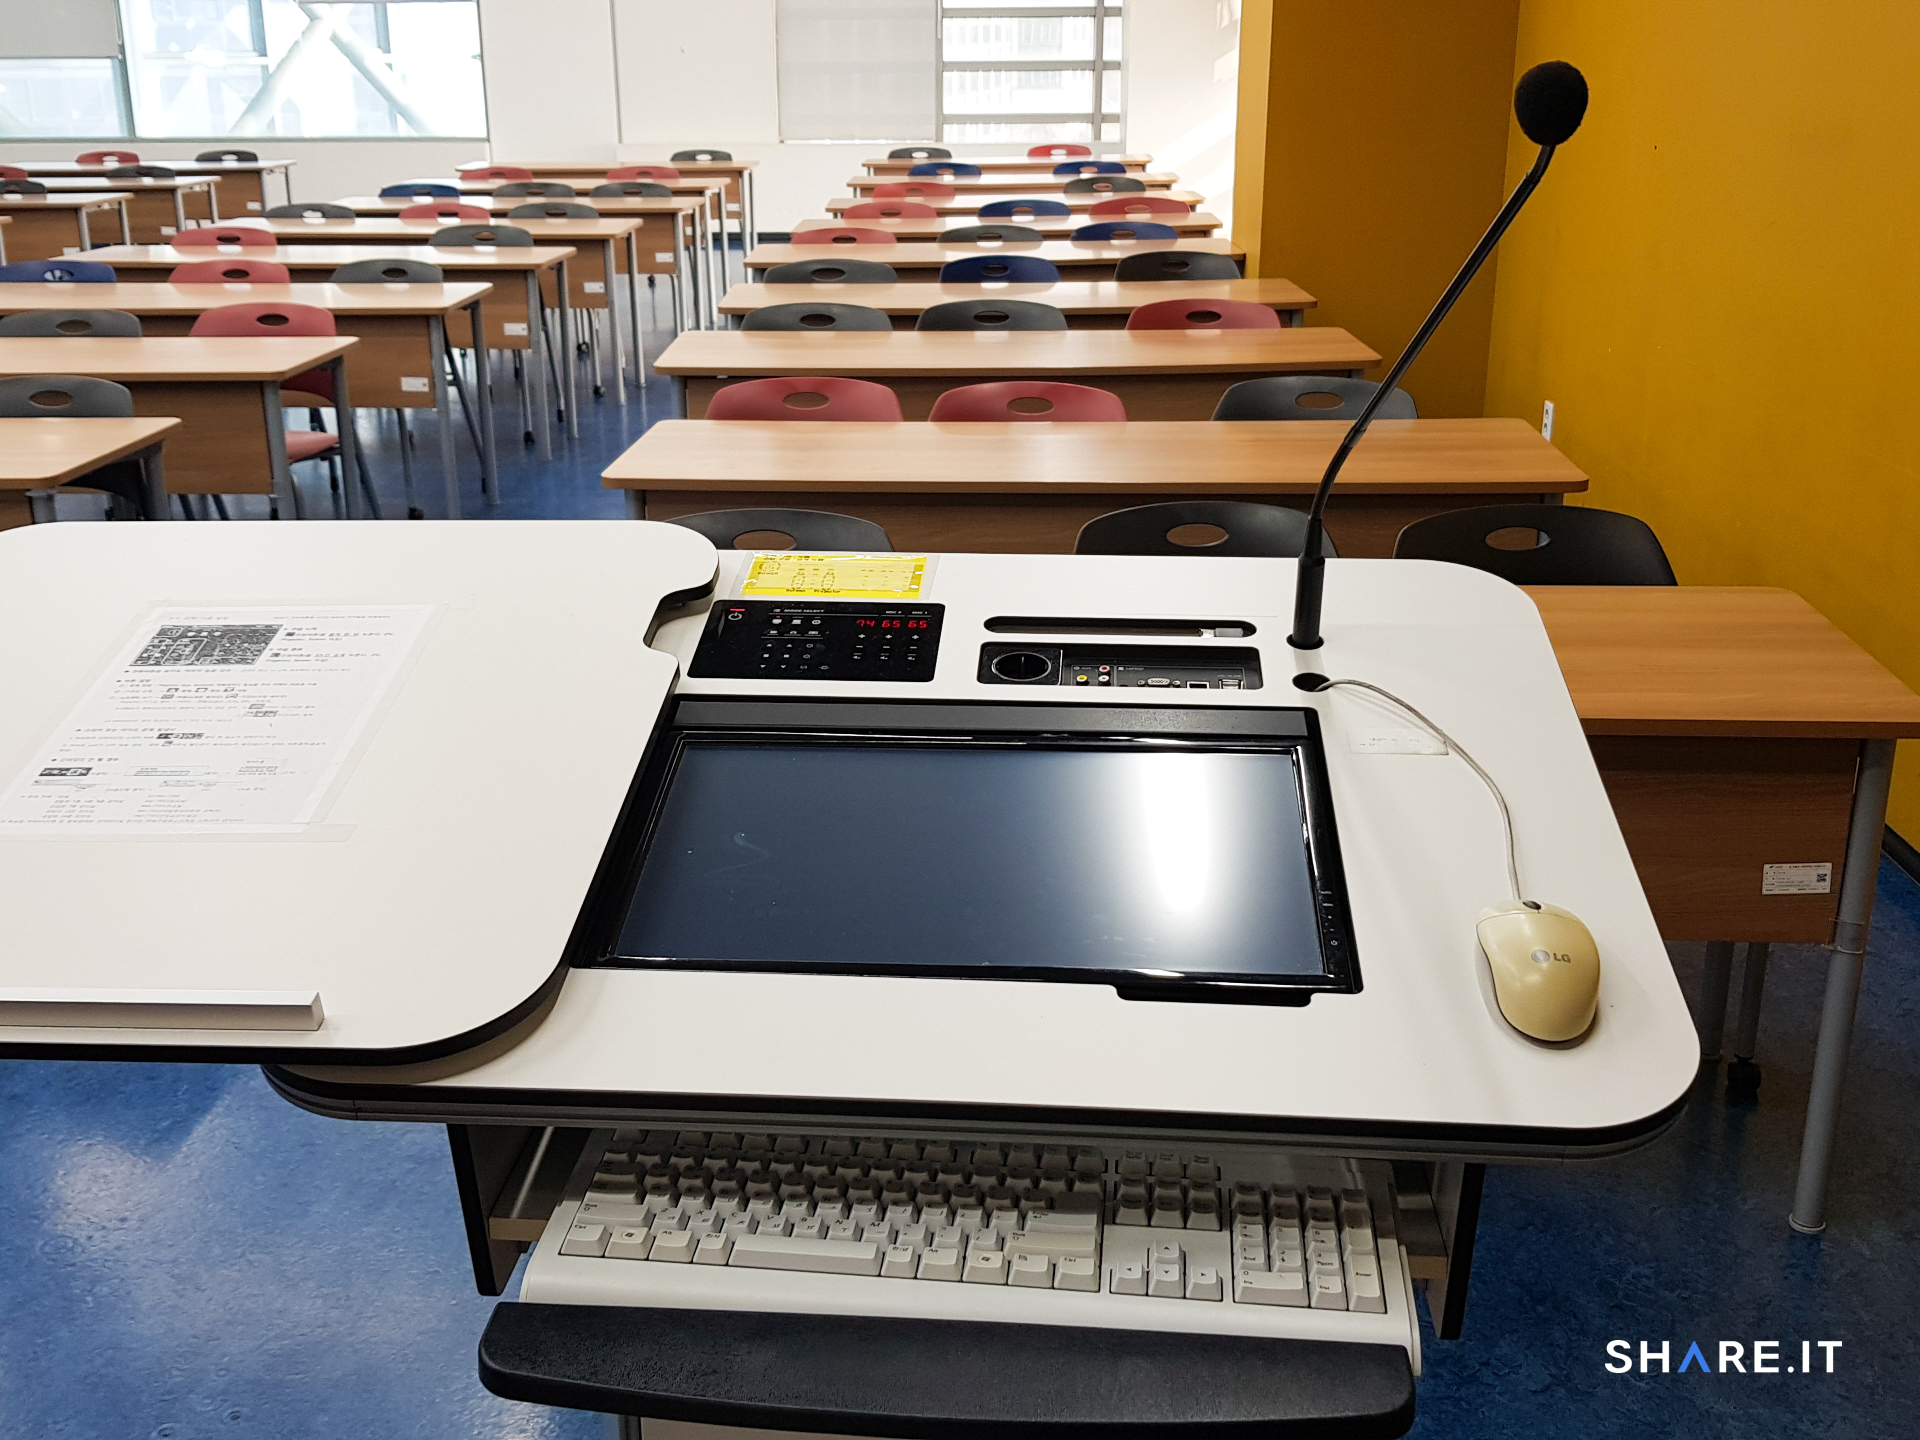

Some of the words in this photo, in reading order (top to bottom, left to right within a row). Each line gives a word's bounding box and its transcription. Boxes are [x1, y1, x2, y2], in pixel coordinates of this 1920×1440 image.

[855, 619, 877, 628] 74
[881, 619, 901, 629] 65
[907, 620, 929, 629] 65
[1553, 952, 1571, 963] LG
